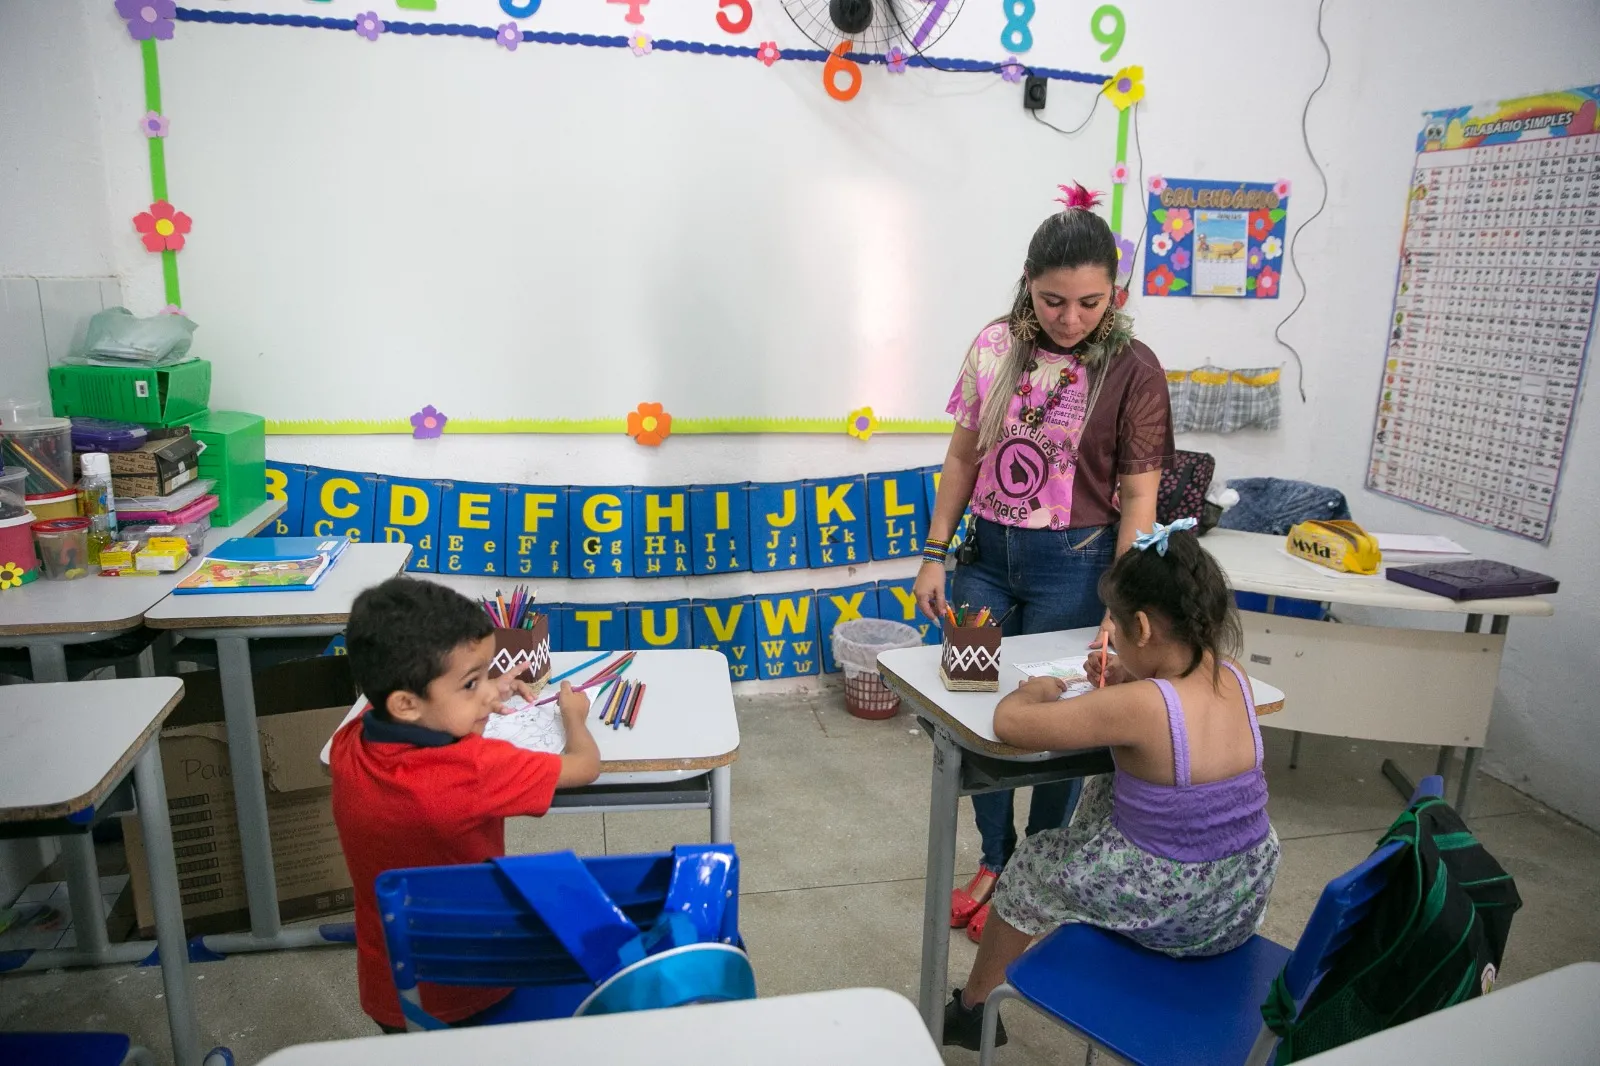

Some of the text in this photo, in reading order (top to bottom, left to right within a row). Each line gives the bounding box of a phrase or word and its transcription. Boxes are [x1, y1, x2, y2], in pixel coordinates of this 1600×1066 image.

[716, 0, 753, 34] 5
[823, 40, 862, 102] 6
[1001, 0, 1036, 53] 8
[1091, 4, 1126, 63] 9
[1464, 112, 1574, 138] SILABÁRIO SIMPLES
[320, 478, 360, 518] C
[389, 485, 429, 526] D
[458, 493, 491, 529] E
[524, 494, 557, 532] F
[582, 494, 623, 533] G
[645, 494, 685, 532] H
[716, 492, 730, 529] I
[766, 489, 797, 527] J
[815, 484, 857, 524] K
[884, 479, 915, 517] L
[985, 490, 1028, 520] Anacé
[276, 520, 289, 534] b
[314, 520, 334, 537] C
[345, 528, 361, 542] c
[384, 527, 406, 543] D
[419, 535, 432, 549] d
[448, 535, 463, 551] E
[484, 540, 496, 552] e
[519, 536, 537, 555] F
[550, 540, 559, 555] f
[582, 536, 602, 555] G
[611, 539, 622, 555] g
[644, 536, 666, 555] H
[674, 539, 686, 553] h
[705, 533, 716, 552] I
[766, 530, 781, 549] J
[820, 526, 840, 546] K
[843, 528, 855, 543] k
[886, 519, 903, 538] L
[575, 586, 918, 647] T U V W X Y
[761, 640, 785, 659] W
[792, 640, 813, 655] w
